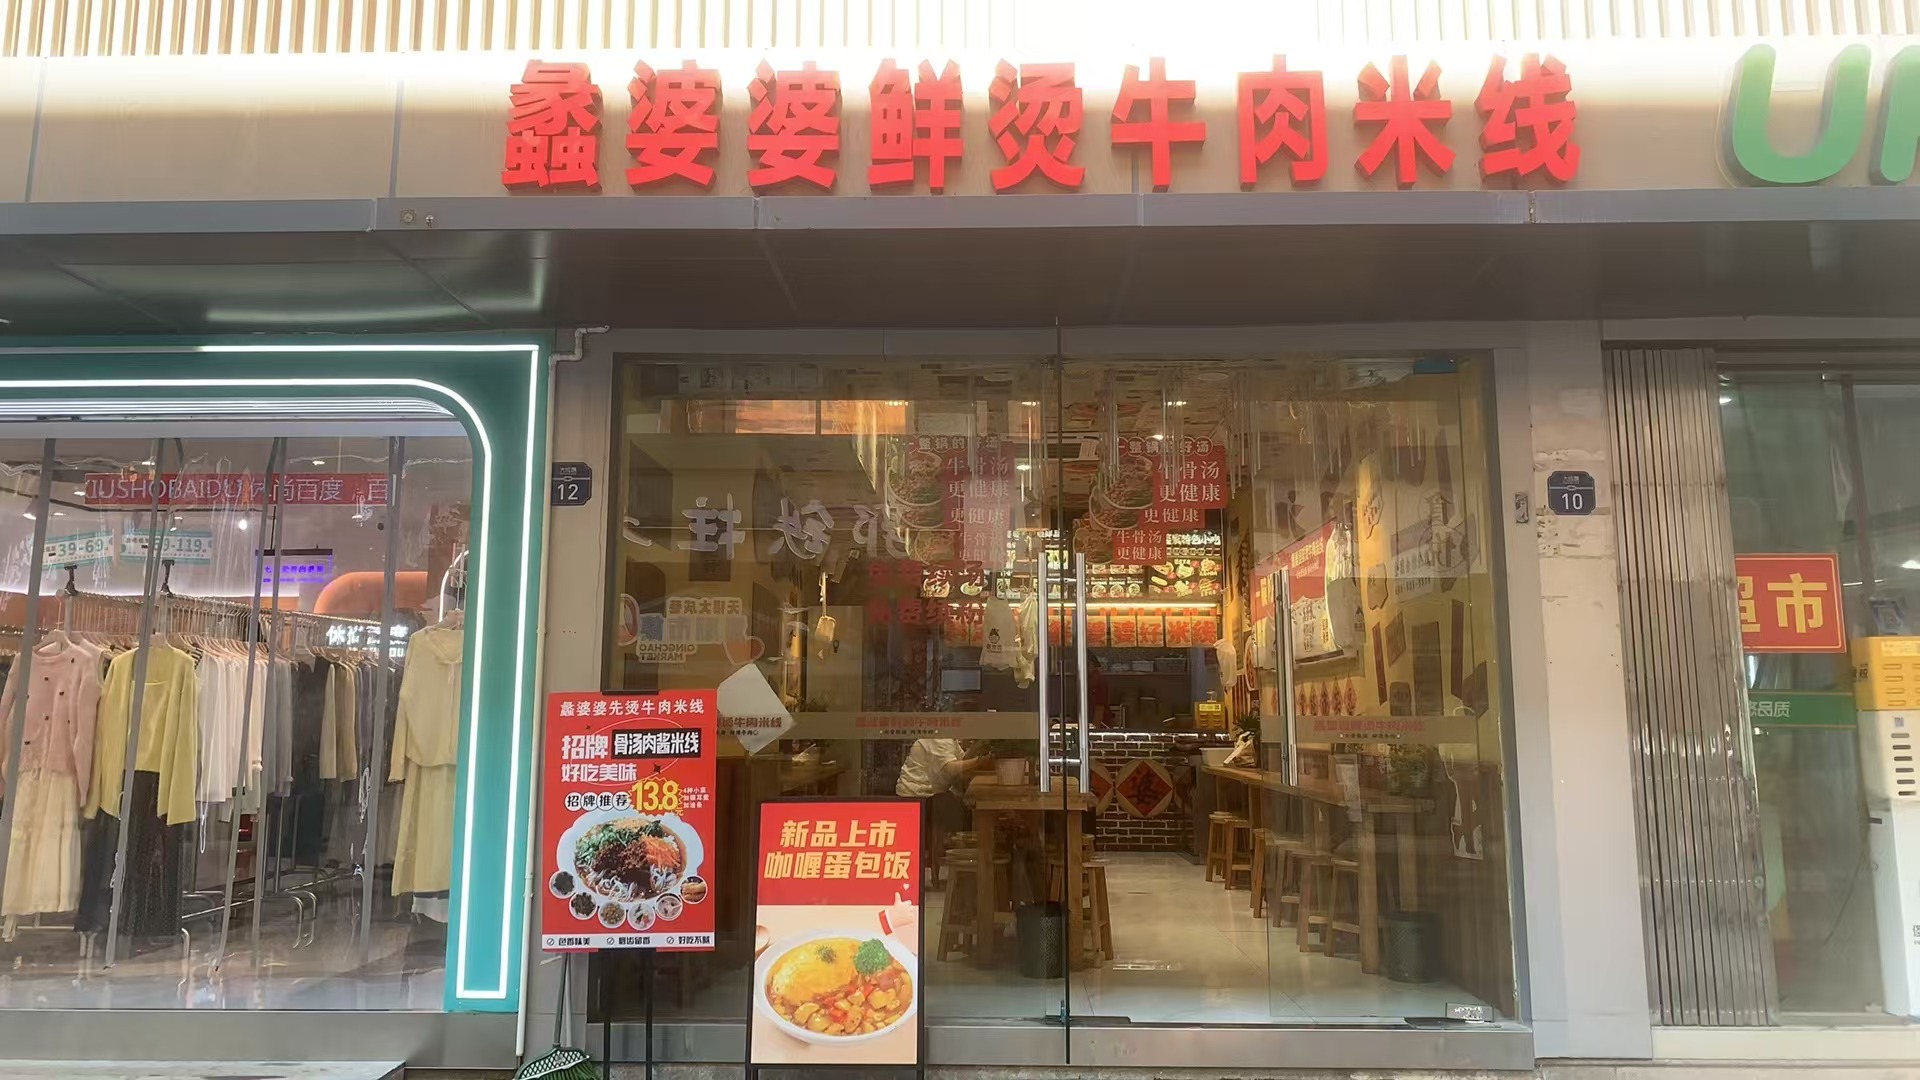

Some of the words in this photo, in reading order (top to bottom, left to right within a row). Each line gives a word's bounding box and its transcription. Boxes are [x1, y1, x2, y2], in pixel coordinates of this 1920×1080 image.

[501, 56, 1582, 192] 蠡婆婆鲜烫牛肉米线
[558, 484, 579, 500] 12
[1160, 483, 1220, 503] 更健康
[1561, 493, 1583, 510] 10
[1144, 508, 1199, 523] 更健康
[1117, 529, 1161, 544] 牛骨汤
[1117, 546, 1162, 560] 更健康
[560, 698, 705, 717] 蠡婆婆先烫牛肉米线
[562, 735, 608, 760] 招牌
[614, 732, 699, 755] 骨汤肉酱米线
[561, 763, 637, 782] 好吃美味
[567, 793, 628, 808] 招牌推荐
[631, 781, 679, 811] 13.8
[780, 819, 897, 848] 新品上市
[764, 851, 911, 880] 咖喱蛋包饭
